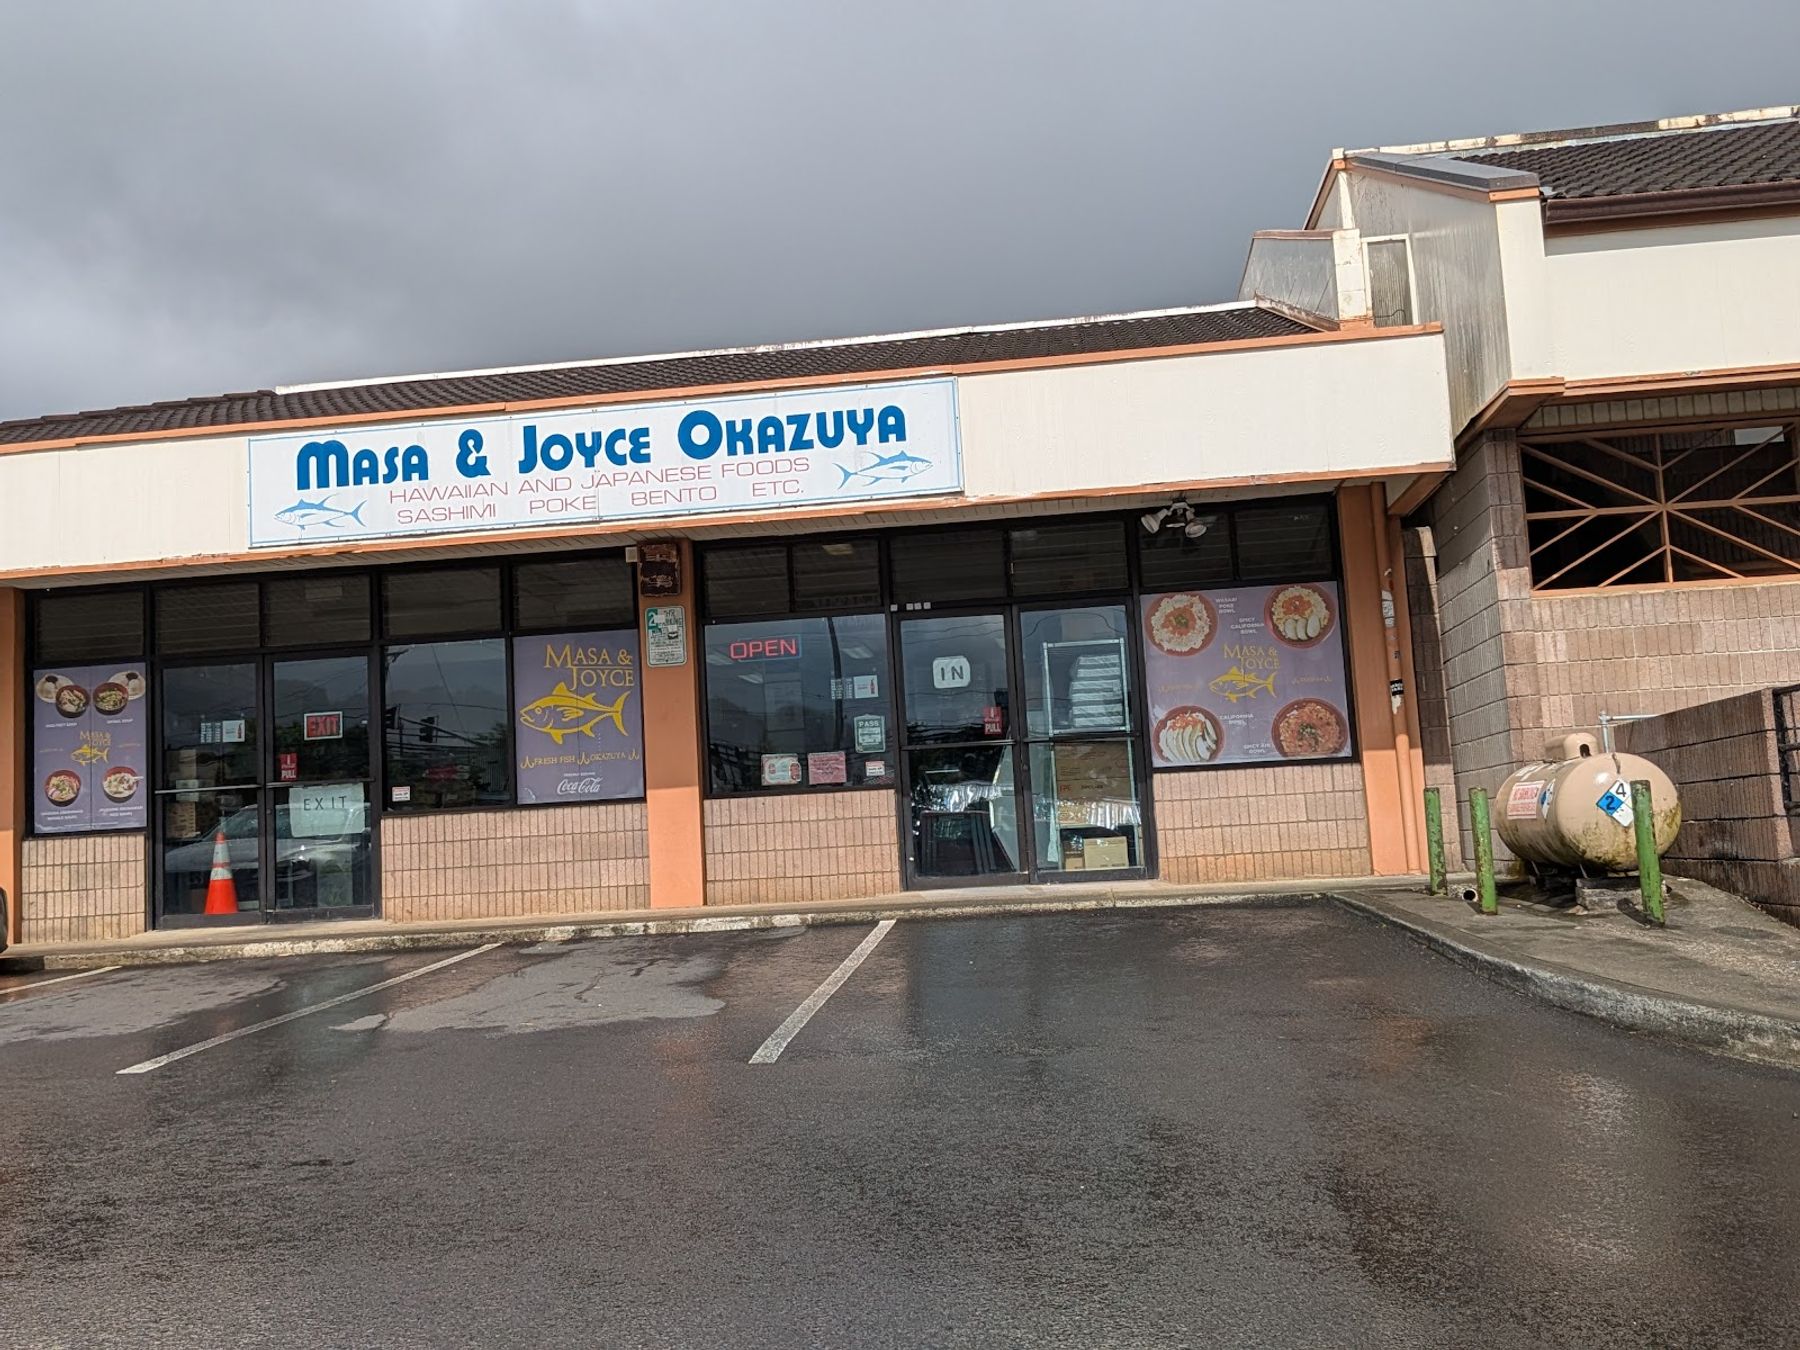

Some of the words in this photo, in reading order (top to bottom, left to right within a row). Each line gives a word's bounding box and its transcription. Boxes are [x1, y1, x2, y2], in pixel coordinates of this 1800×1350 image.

[456, 428, 491, 478] &
[390, 481, 508, 504] HAWAIIAN
[518, 477, 572, 495] AND
[581, 464, 713, 490] JAPANESE
[721, 456, 810, 479] FOODS
[397, 503, 496, 525] SASHIMI
[529, 495, 597, 515] POKE
[631, 486, 717, 507] BENTO
[752, 479, 804, 498] ETC.
[648, 611, 657, 626] 2
[730, 638, 797, 660] OPEN
[617, 649, 632, 665] &
[941, 665, 964, 681] IN
[307, 715, 339, 738] EXIT
[859, 720, 879, 728] PASS
[985, 722, 1001, 734] PULL
[534, 757, 557, 765] FRESH
[560, 755, 575, 763] FISH
[281, 769, 297, 779] PULL
[1616, 783, 1627, 798] 4
[1605, 796, 1616, 811] 2
